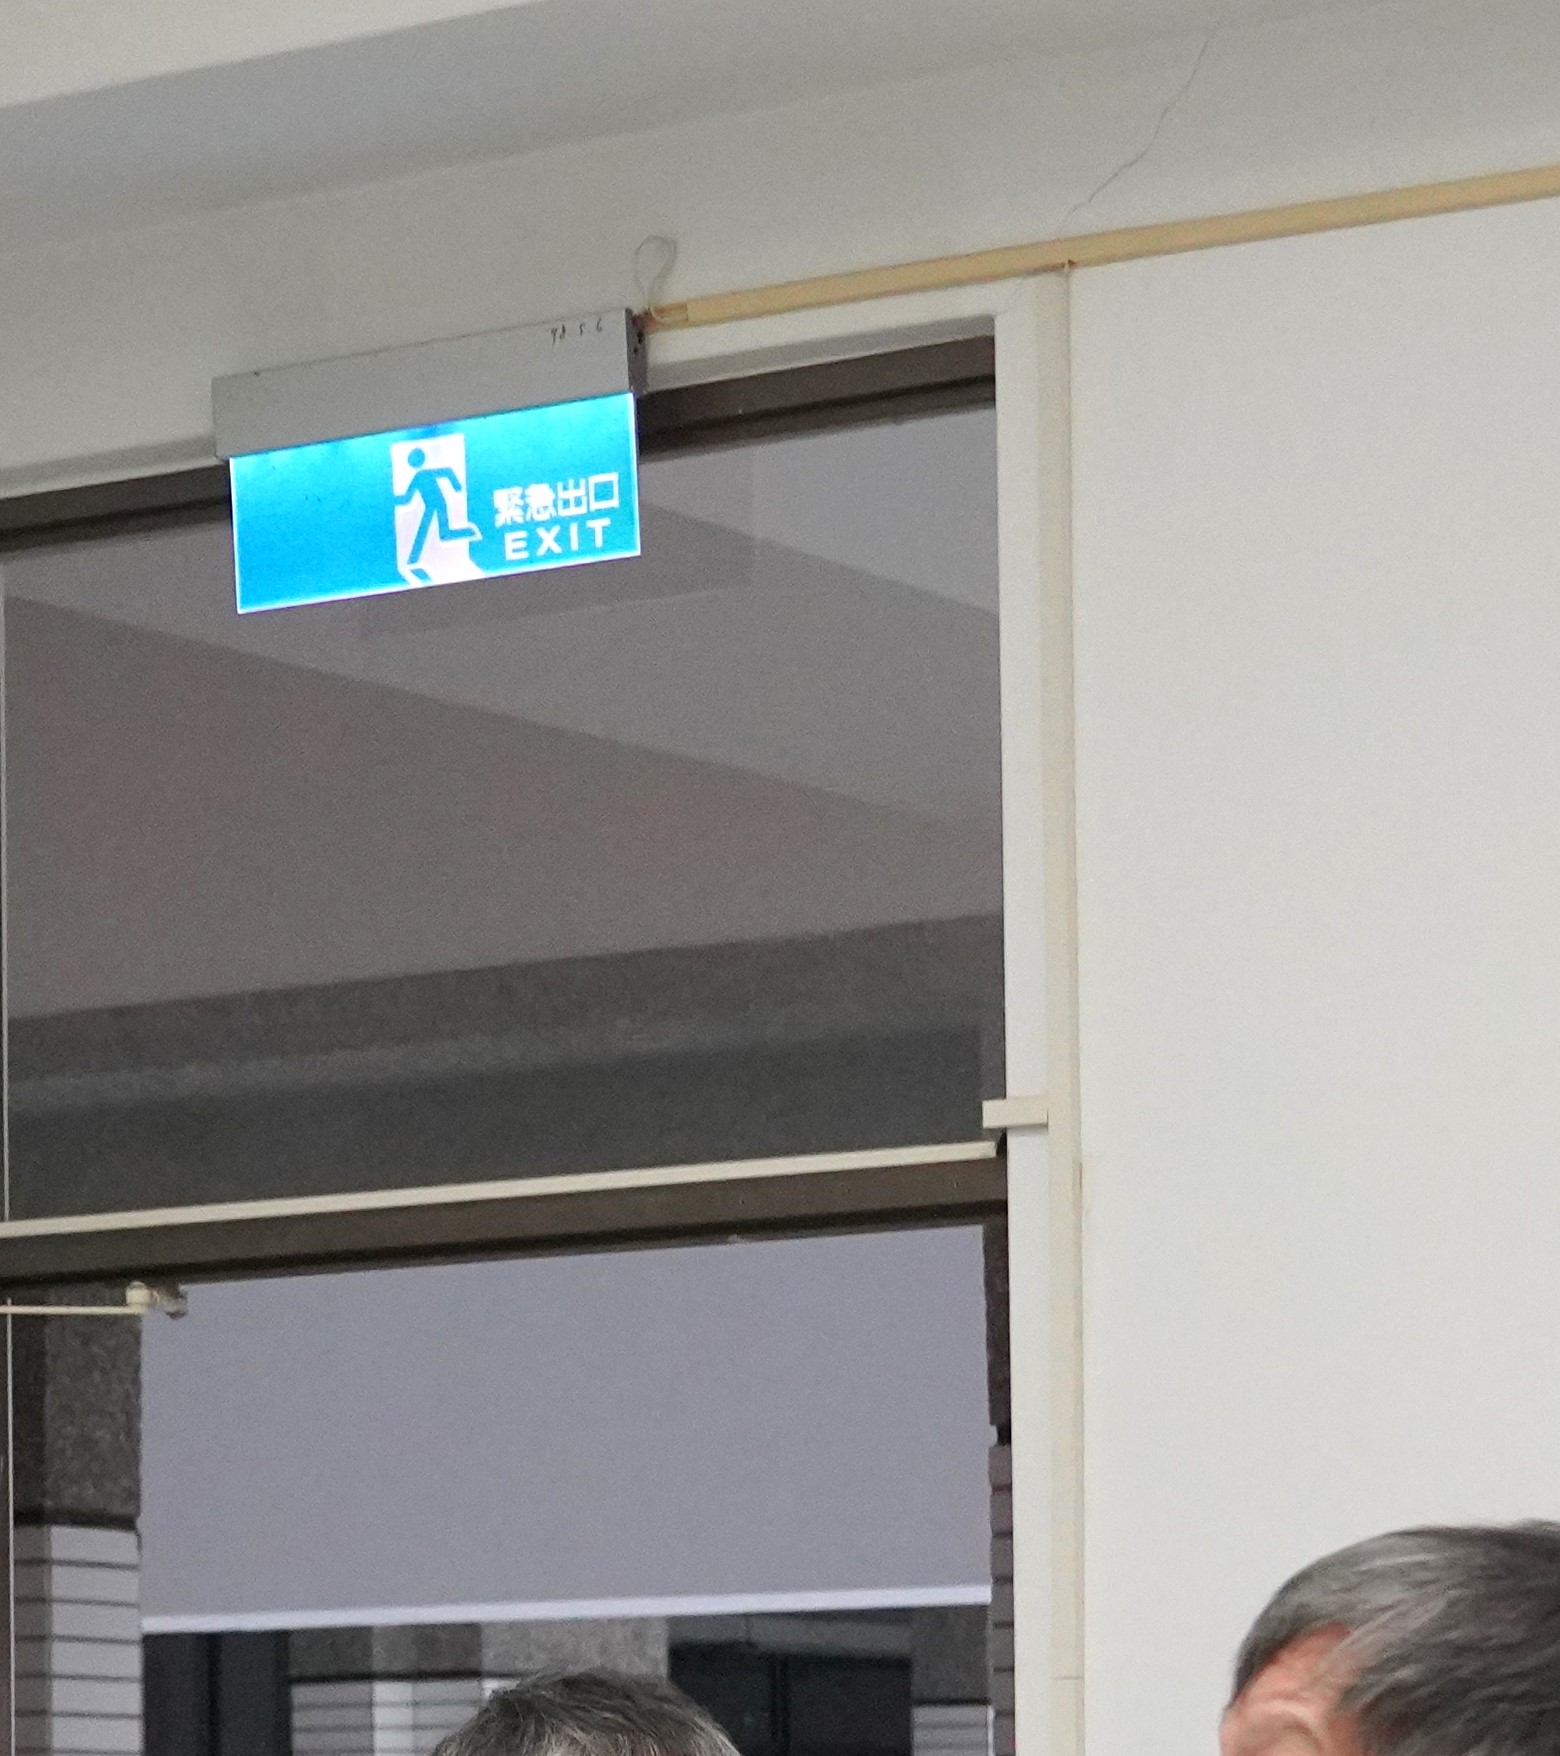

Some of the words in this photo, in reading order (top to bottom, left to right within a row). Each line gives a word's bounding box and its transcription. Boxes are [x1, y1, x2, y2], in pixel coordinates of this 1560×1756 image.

[493, 472, 620, 528] 緊急出口
[503, 517, 612, 561] EXIT
